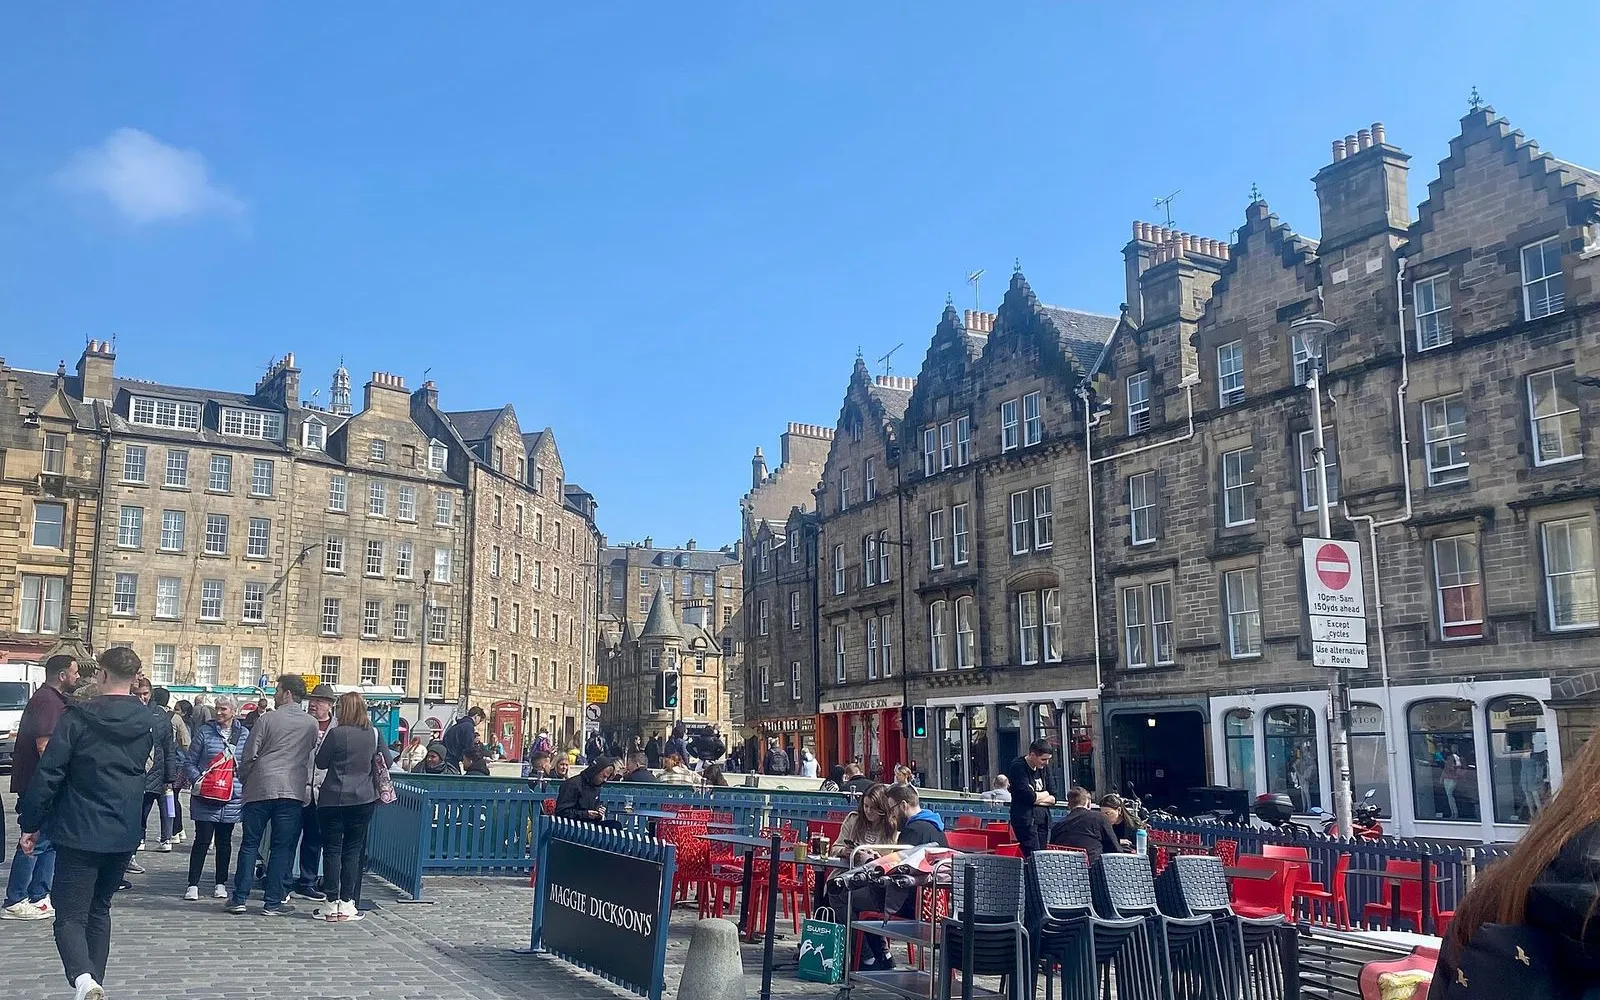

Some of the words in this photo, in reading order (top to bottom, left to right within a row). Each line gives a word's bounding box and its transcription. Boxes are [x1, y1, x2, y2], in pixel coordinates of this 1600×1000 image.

[1317, 593, 1354, 602] 10pm-5am
[1314, 602, 1338, 612] 150yds
[1340, 604, 1360, 613] ahead
[1327, 620, 1350, 629] Except
[1329, 630, 1349, 638] cycles
[1315, 645, 1329, 653] Use
[1330, 646, 1365, 655] alternative
[1331, 656, 1351, 664] Route
[839, 700, 870, 710] ARMSTRONG
[876, 698, 888, 707] SON
[550, 883, 587, 914] MAGGIE
[590, 896, 653, 937] DICKSON'S
[806, 924, 832, 934] SWISH
